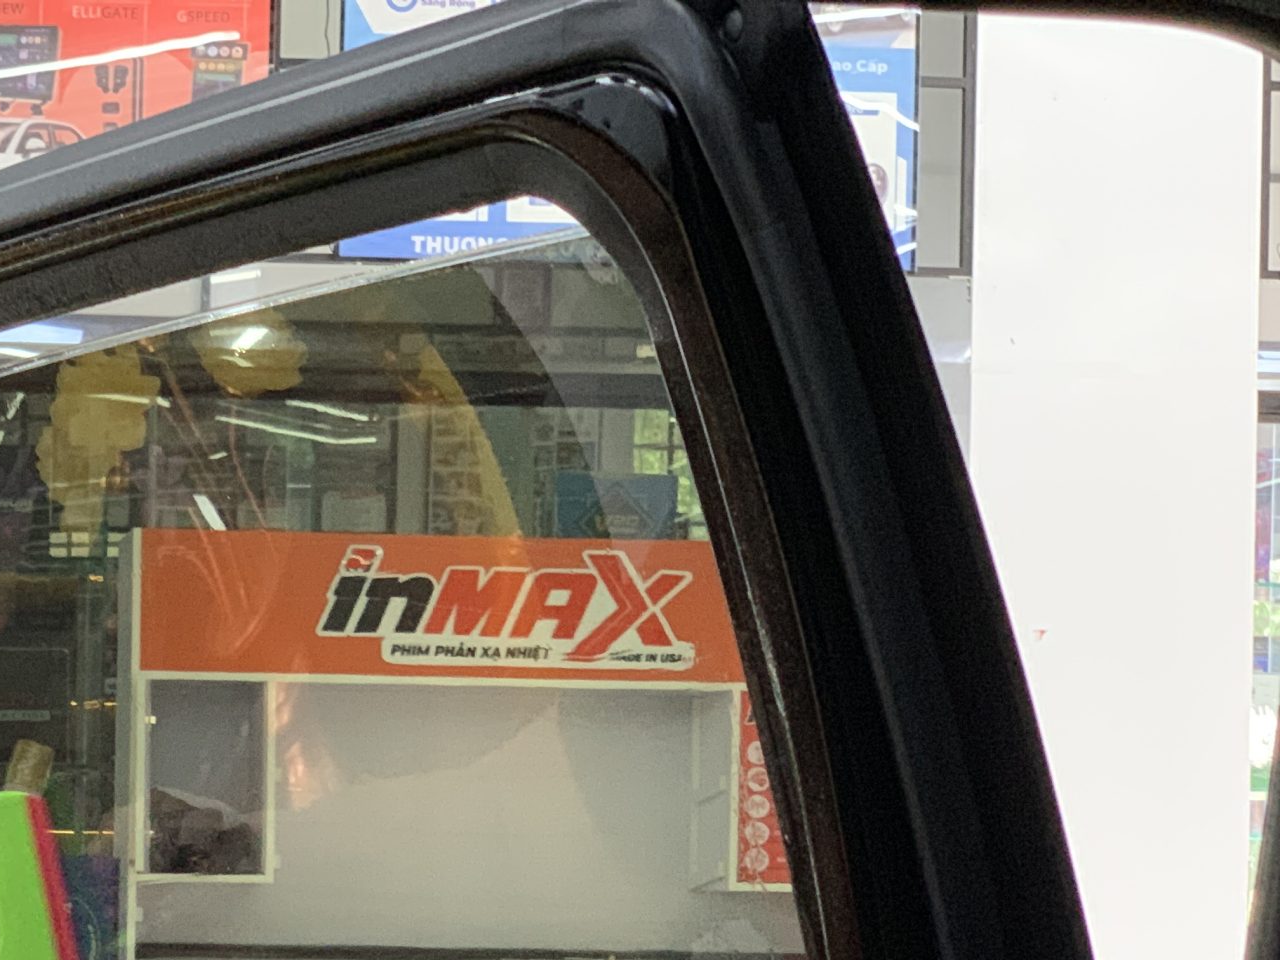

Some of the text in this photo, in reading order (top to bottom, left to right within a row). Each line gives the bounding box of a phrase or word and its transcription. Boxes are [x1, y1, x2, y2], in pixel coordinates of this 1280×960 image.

[71, 5, 139, 20] ELLIGATE
[176, 10, 231, 23] GSPEED
[832, 60, 852, 72] ao
[390, 644, 430, 657] PHIM
[645, 653, 658, 663] IN
